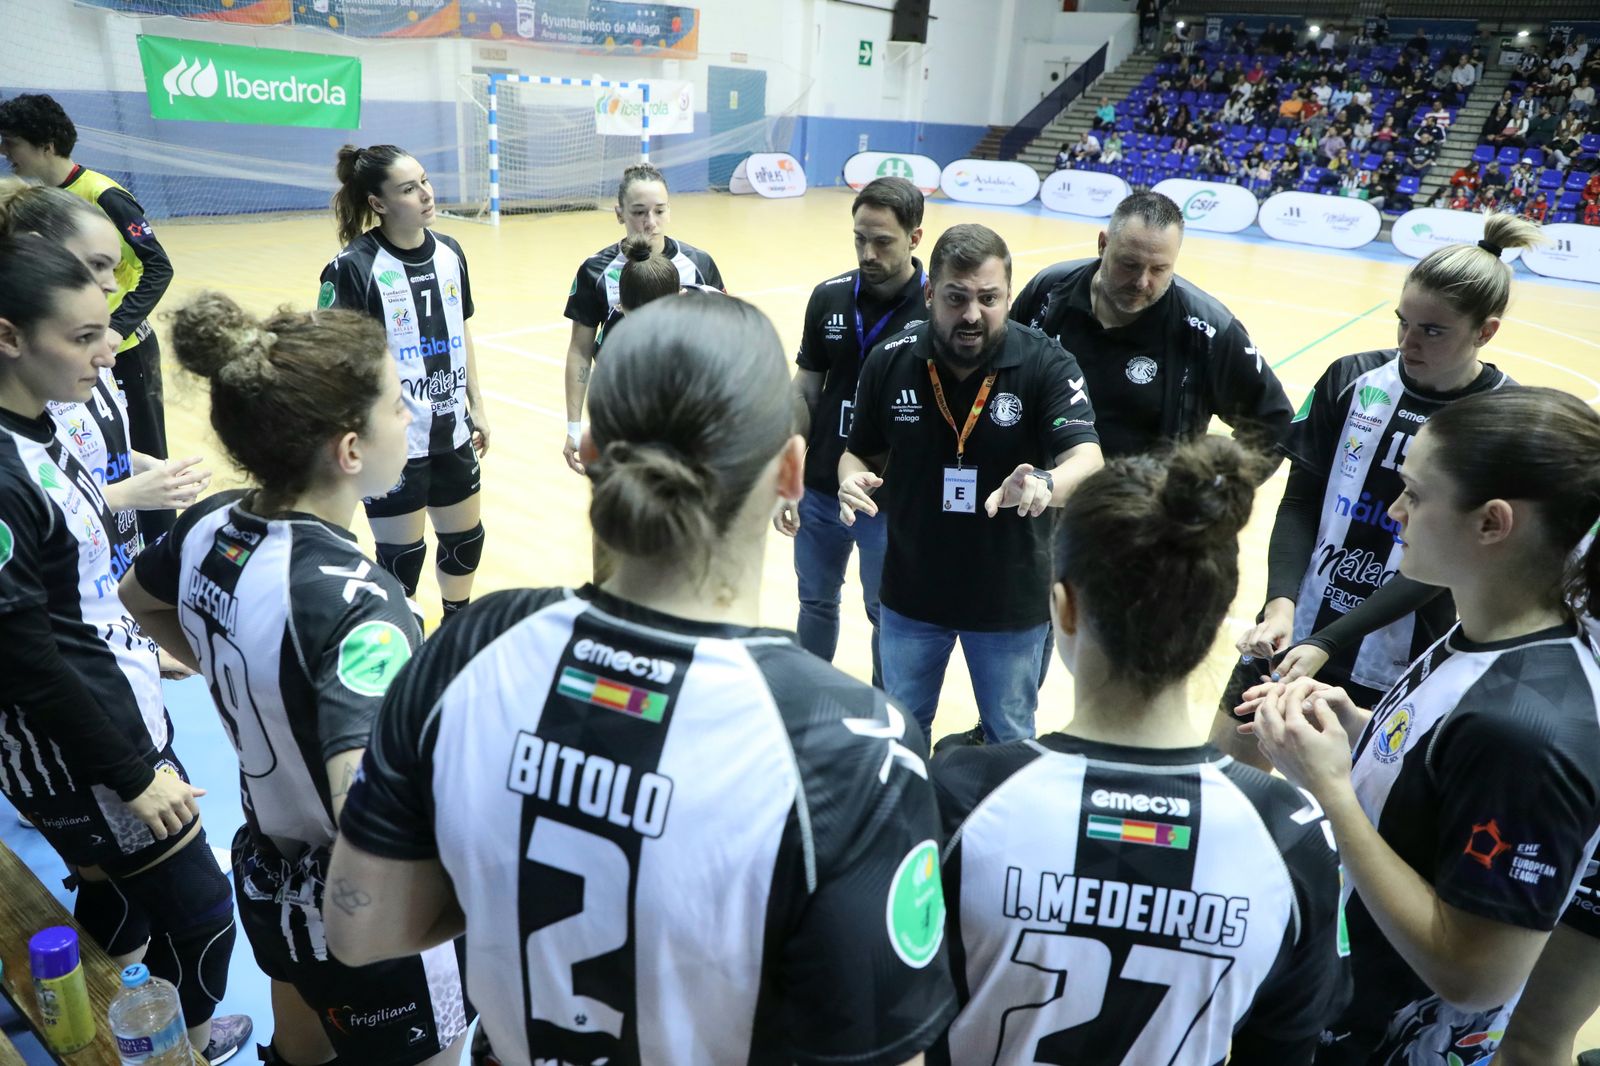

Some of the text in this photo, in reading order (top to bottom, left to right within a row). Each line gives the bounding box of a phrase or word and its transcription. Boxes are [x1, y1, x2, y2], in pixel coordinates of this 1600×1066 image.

[541, 11, 660, 37] Ayuntamiento de Málaga
[224, 69, 347, 106] Iberdrola
[1190, 198, 1220, 212] CSIF
[421, 289, 432, 317] 7
[91, 386, 114, 421] 4
[955, 487, 965, 500] E
[187, 565, 239, 637] PESSOA
[573, 638, 652, 678] emec
[507, 730, 674, 839] BITOLO
[1090, 789, 1170, 815] emec
[1517, 843, 1541, 853] EHF
[1509, 868, 1540, 884] LEAGUE
[1512, 856, 1557, 877] EUROPEAN
[1002, 866, 1250, 948] I.MEDEIROS
[526, 815, 631, 1040] 2
[989, 929, 1236, 1066] 27
[350, 1000, 417, 1027] frigiliana
